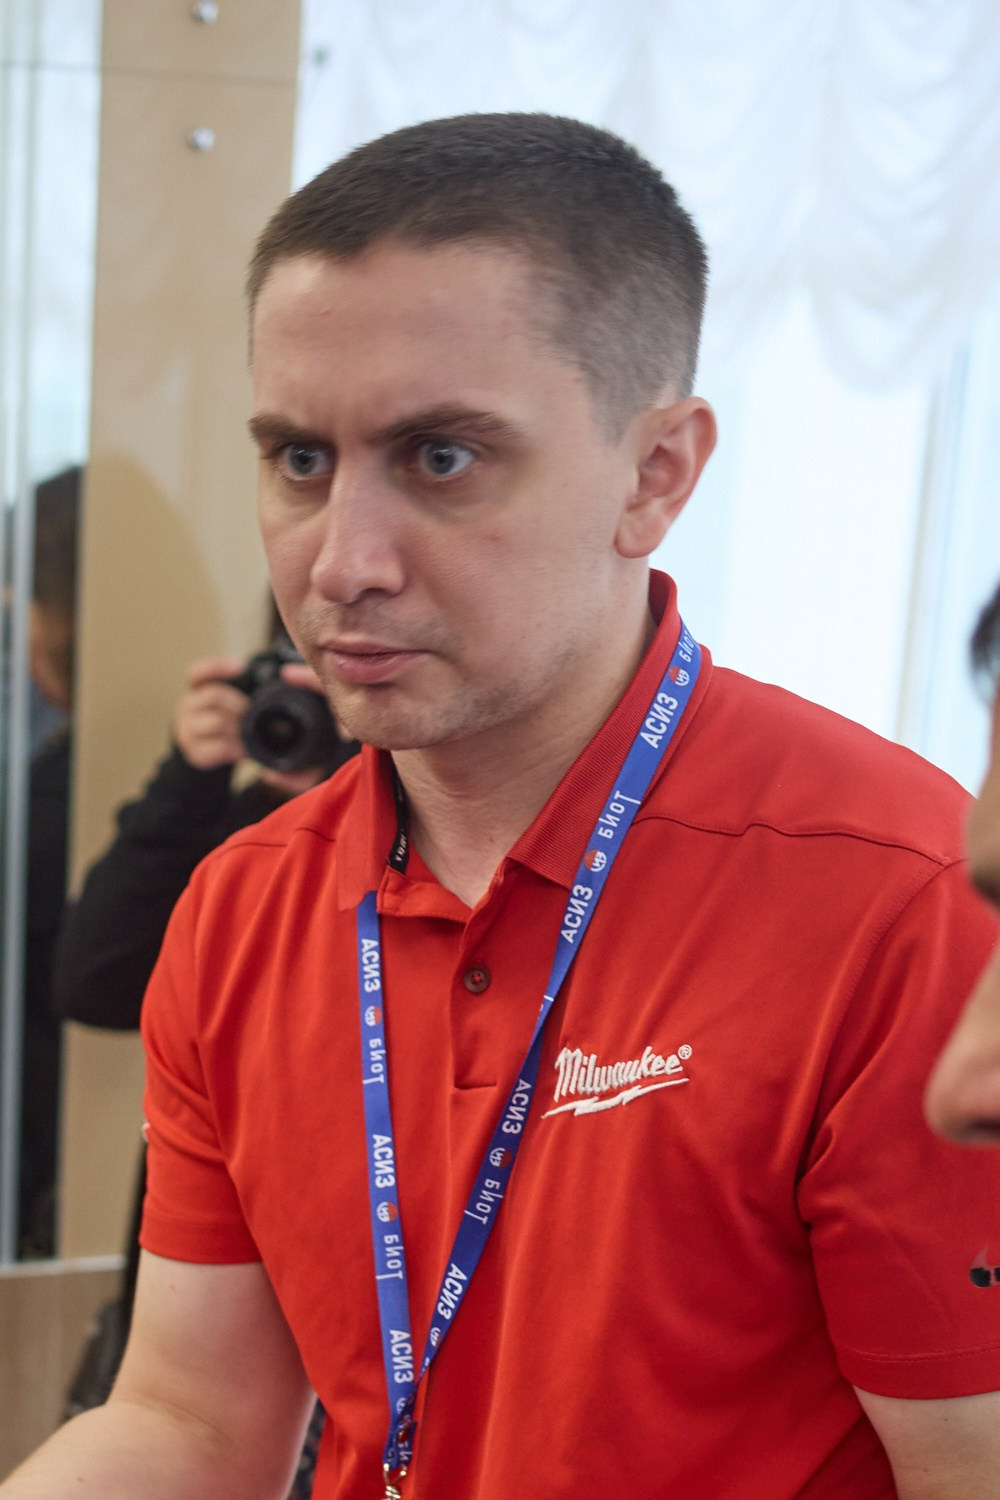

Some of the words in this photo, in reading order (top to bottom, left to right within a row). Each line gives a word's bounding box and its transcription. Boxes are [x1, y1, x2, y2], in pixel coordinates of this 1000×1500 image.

[640, 692, 679, 749] АСИЗ
[598, 790, 641, 839] БИОТ
[560, 884, 593, 943] АСИЗ
[361, 938, 381, 993] АСИЗ
[362, 1037, 387, 1085] БИОТ
[502, 1078, 532, 1135] АСИЗ
[372, 1134, 396, 1189] АСИЗ
[464, 1178, 504, 1225] БИОТ
[375, 1233, 405, 1280] БИОТ
[437, 1262, 468, 1320] АСИЗ
[389, 1329, 414, 1384] АСИЗ
